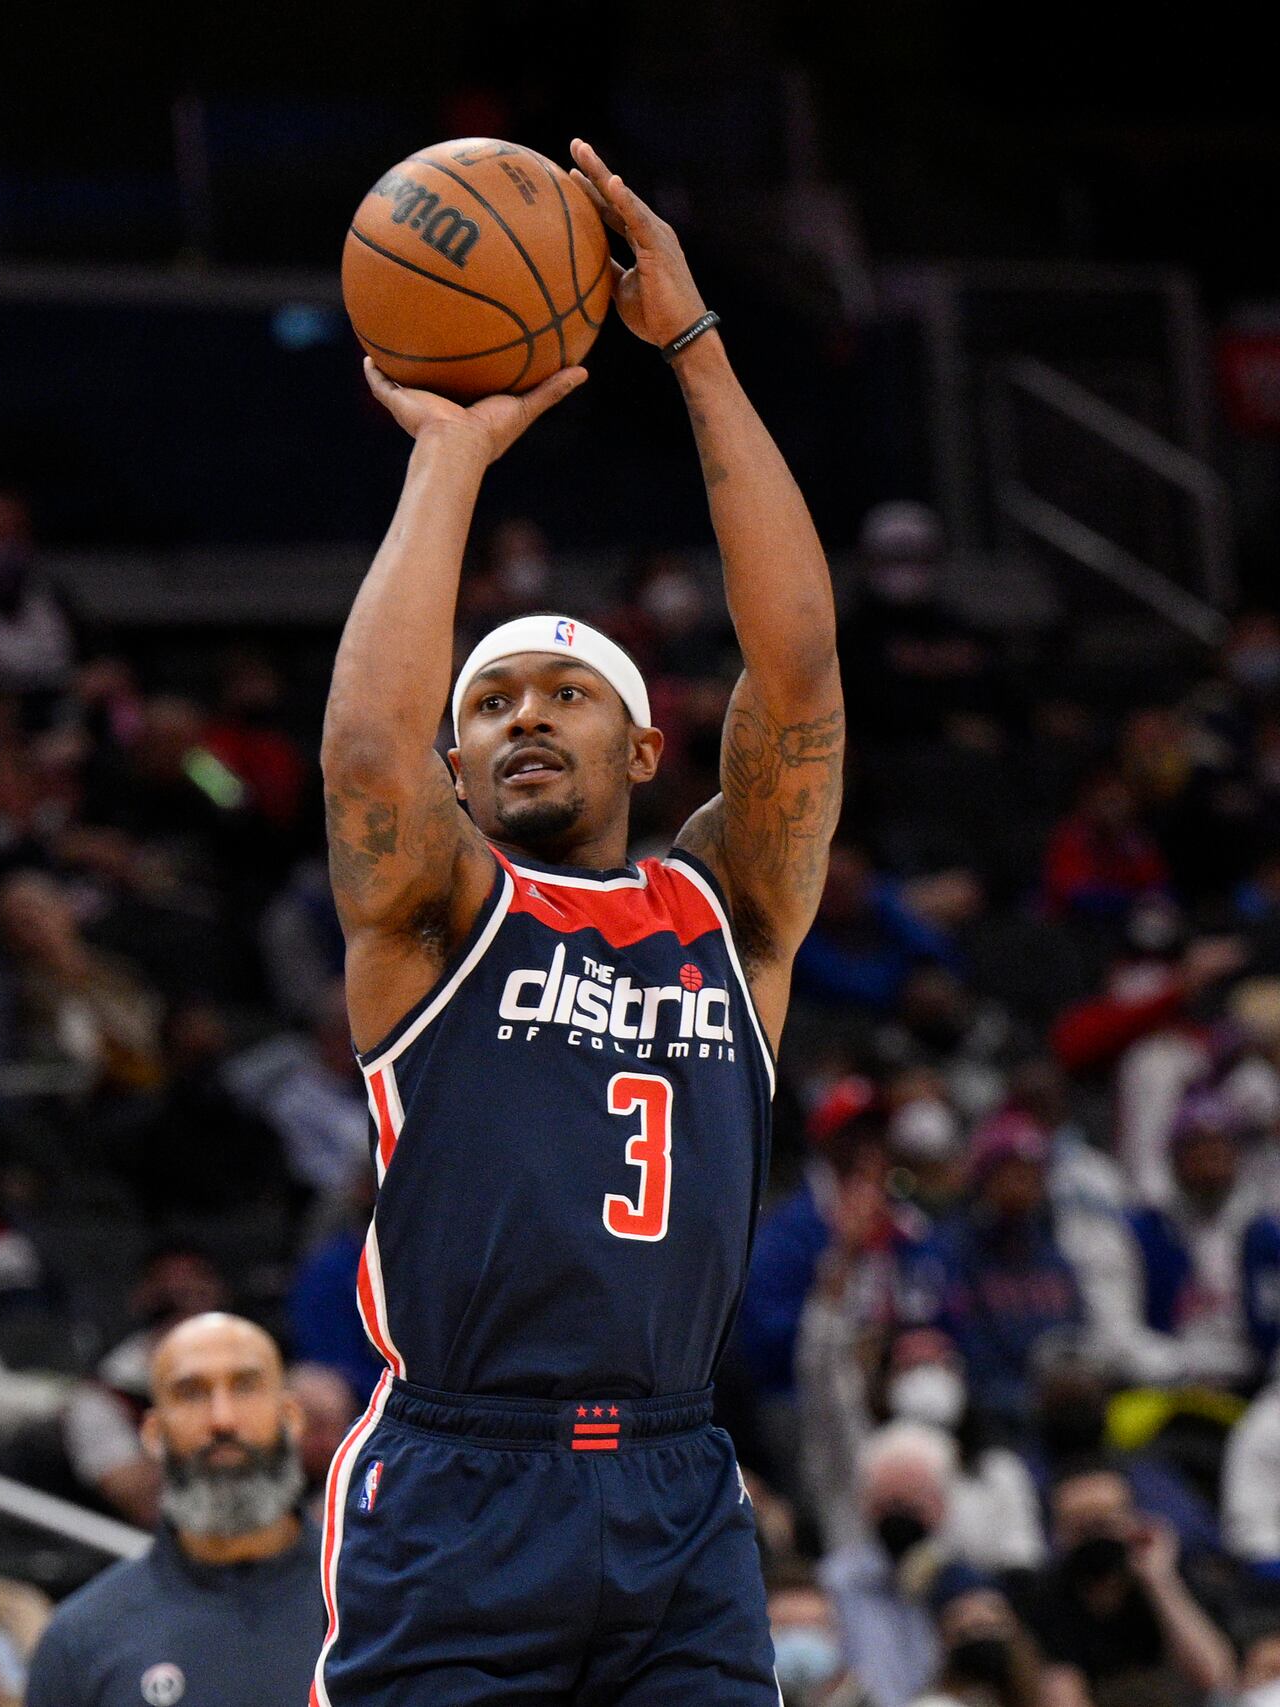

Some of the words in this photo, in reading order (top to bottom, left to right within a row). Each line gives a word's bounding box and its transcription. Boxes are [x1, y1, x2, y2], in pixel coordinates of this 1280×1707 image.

[371, 172, 480, 270] Wil
[582, 955, 616, 985] THE
[497, 1024, 540, 1042] OF
[567, 1030, 736, 1063] COLUMBIA
[602, 1071, 674, 1243] 3
